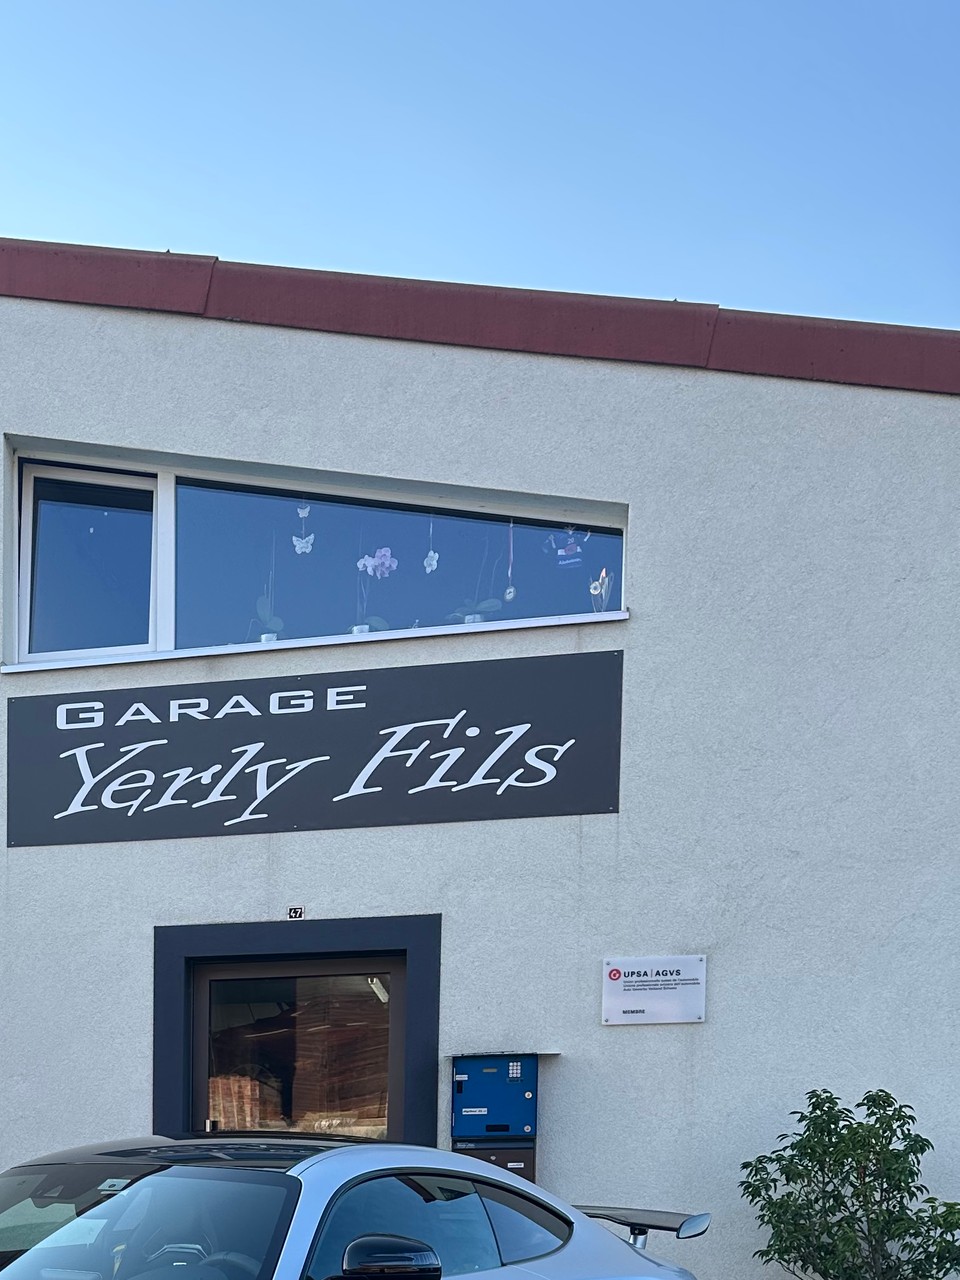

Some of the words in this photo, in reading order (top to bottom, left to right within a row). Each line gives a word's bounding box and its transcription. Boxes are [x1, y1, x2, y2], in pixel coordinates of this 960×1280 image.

[56, 685, 367, 730] GARAGE
[53, 739, 331, 827] Yerly
[333, 709, 575, 802] Fils
[290, 908, 302, 918] 47
[623, 971, 649, 979] UPSA
